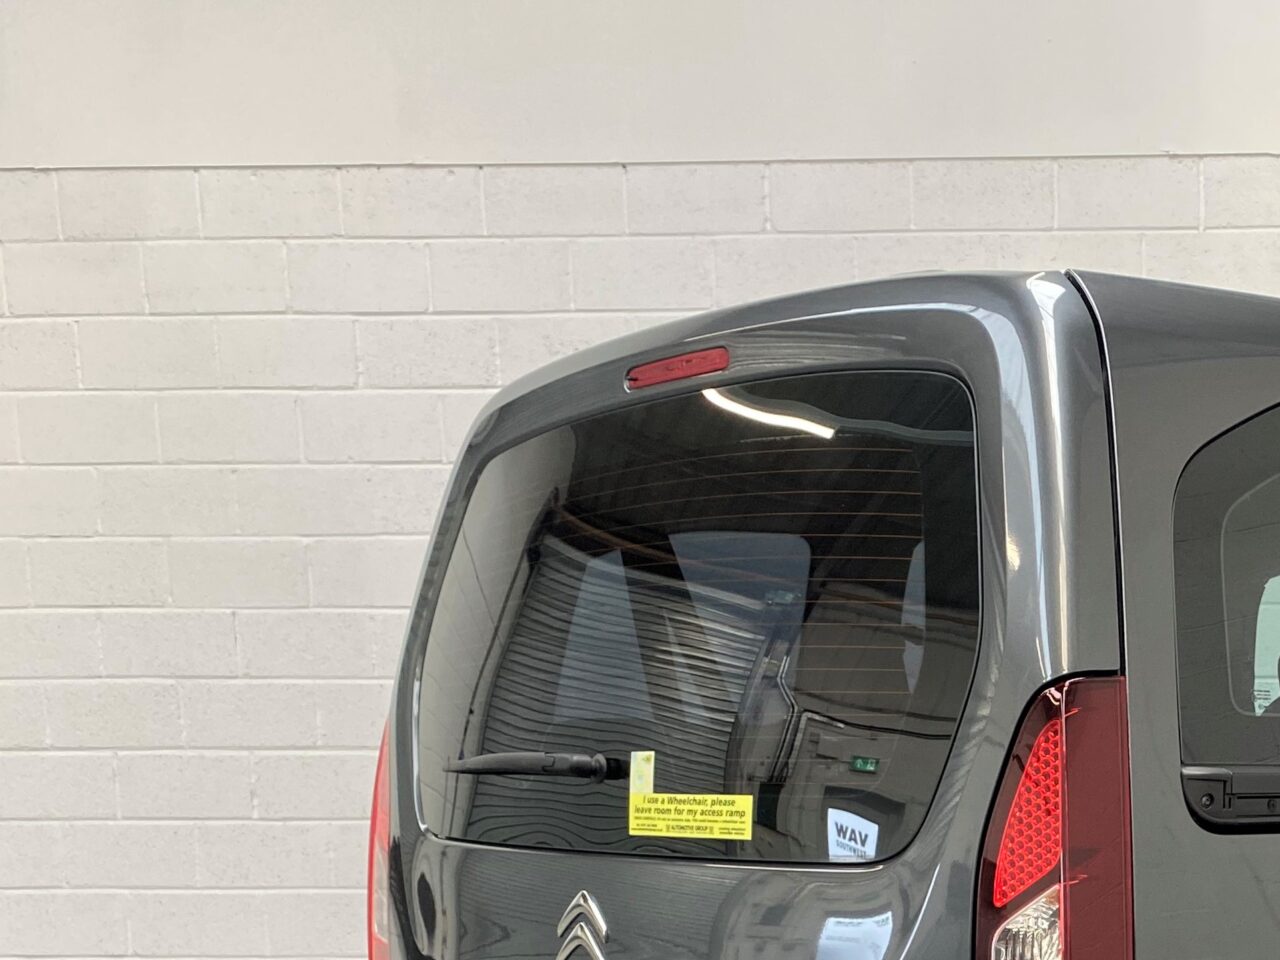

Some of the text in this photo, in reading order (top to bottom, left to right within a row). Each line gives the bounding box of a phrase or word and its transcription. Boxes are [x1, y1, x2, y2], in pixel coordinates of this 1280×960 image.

[647, 797, 659, 805] use
[667, 796, 709, 807] Wheelchair,
[710, 797, 736, 808] please
[634, 805, 746, 818] leave room for my access ramp
[834, 821, 869, 848] WAV
